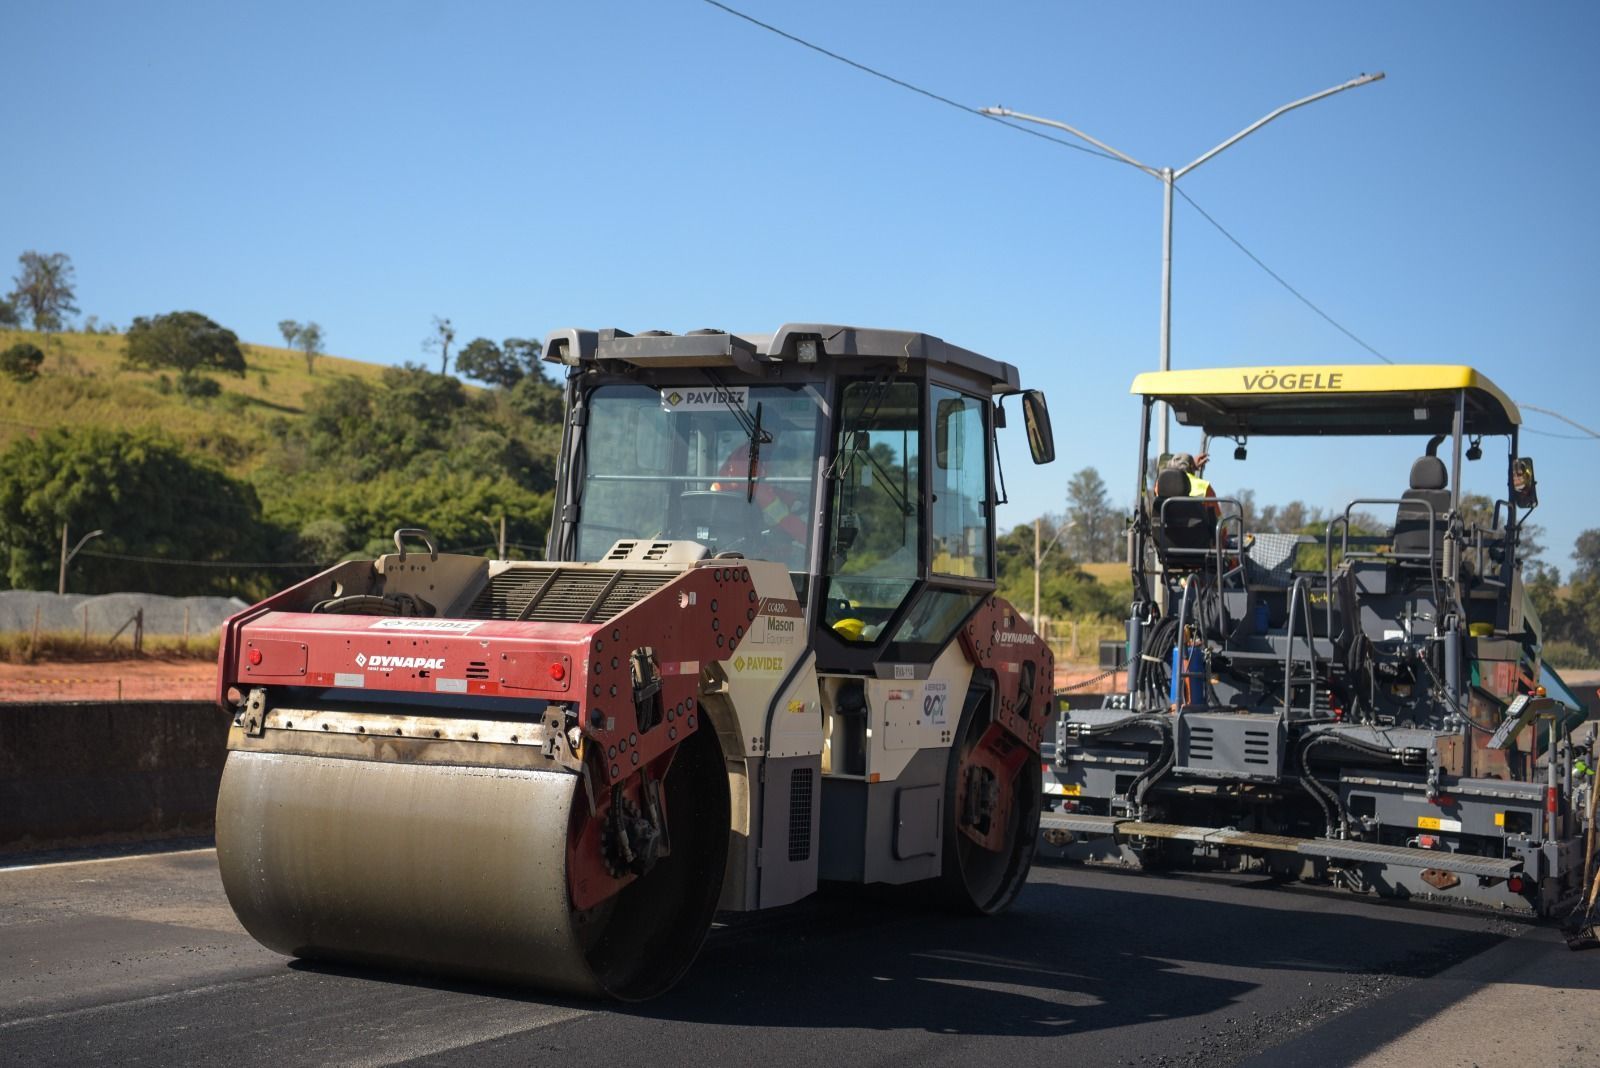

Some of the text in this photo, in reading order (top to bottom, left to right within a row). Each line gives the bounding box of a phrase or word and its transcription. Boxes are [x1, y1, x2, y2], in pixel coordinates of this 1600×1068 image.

[1243, 370, 1343, 390] VÖGELE
[687, 391, 744, 404] PAVIDEZ
[405, 621, 476, 629] PAVIDEZ
[767, 617, 794, 632] Mason
[1001, 632, 1036, 645] DYNAPAC
[368, 655, 446, 670] DYNAPAC
[747, 656, 783, 671] PAVIDEZ
